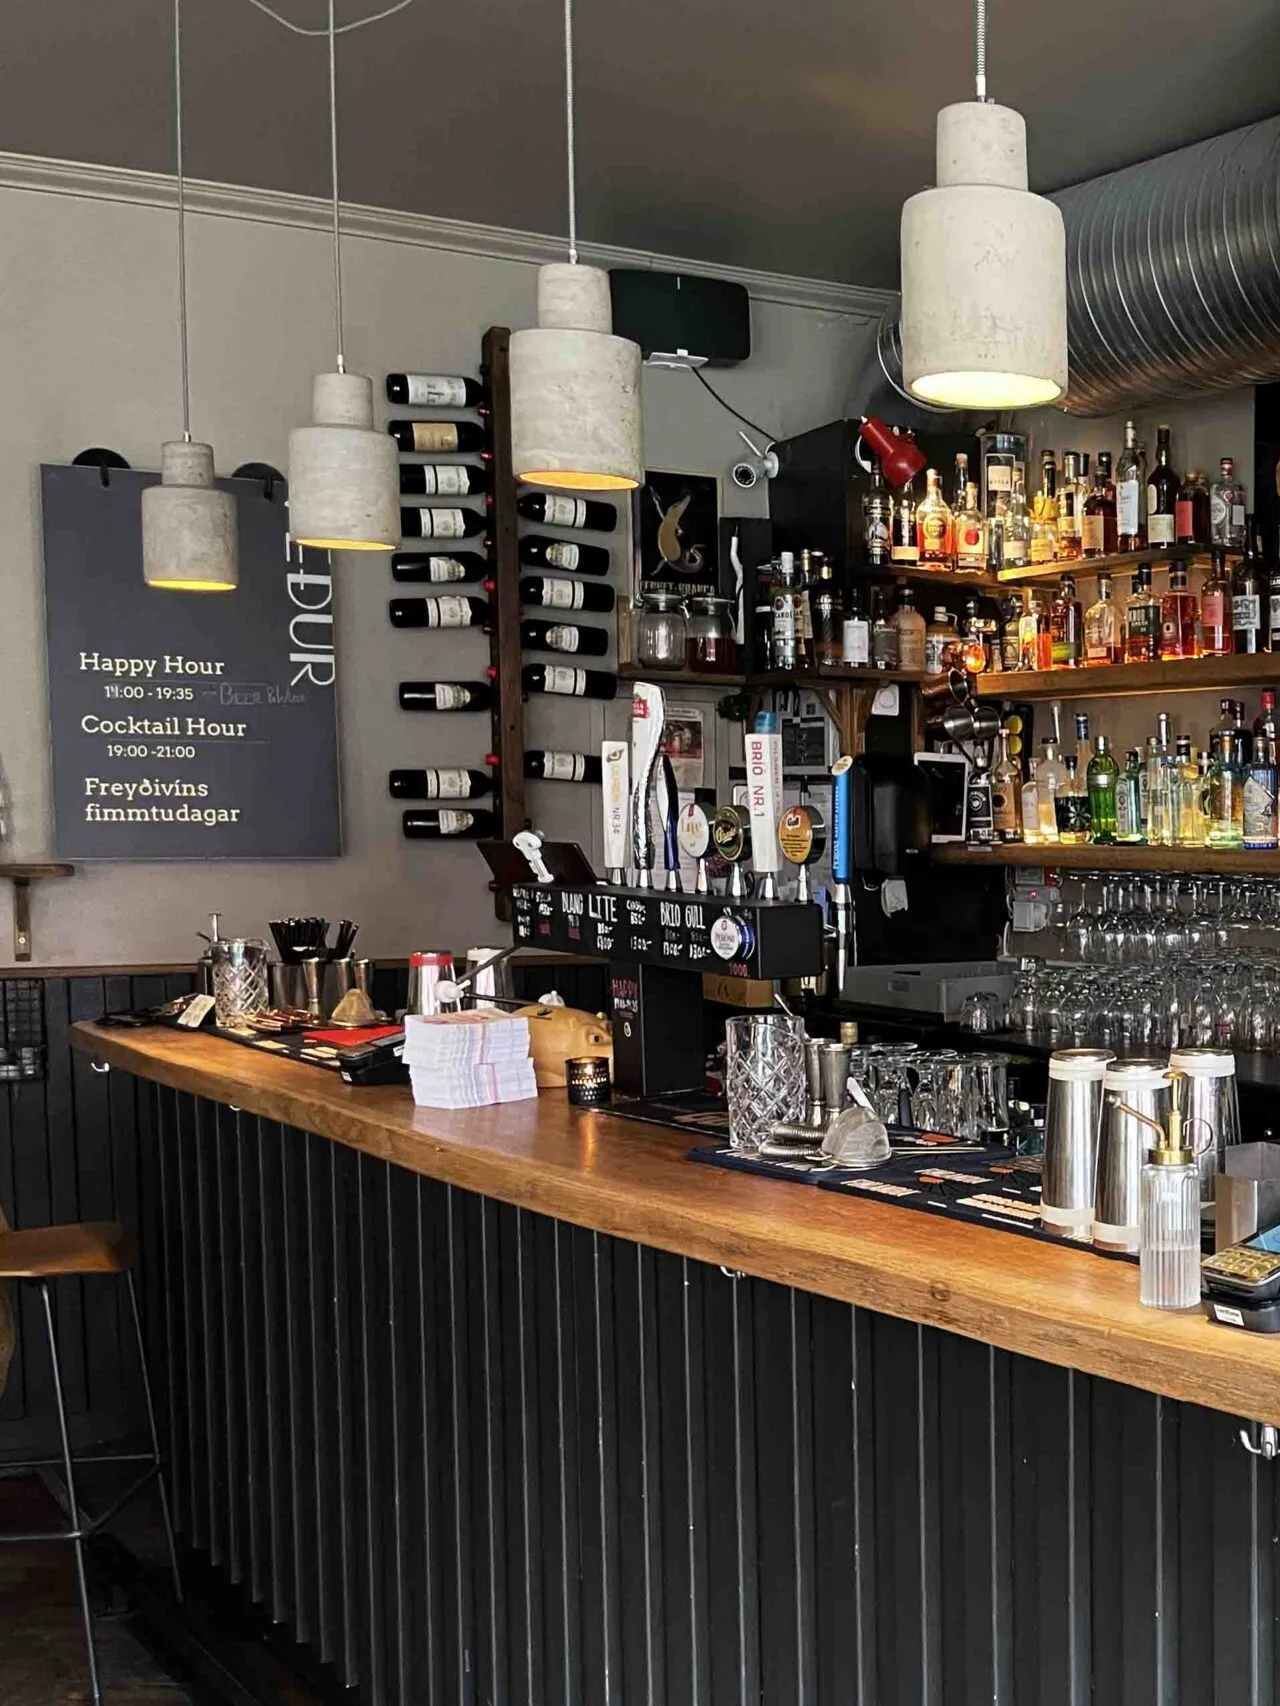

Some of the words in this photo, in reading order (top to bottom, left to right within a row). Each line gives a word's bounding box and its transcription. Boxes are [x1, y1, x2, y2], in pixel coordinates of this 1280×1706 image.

[284, 500, 336, 686] EÐUR
[79, 652, 156, 677] Happy
[163, 656, 225, 676] Hour
[156, 686, 194, 701] 19:35
[81, 714, 181, 737] Cocktail
[186, 718, 247, 737] Hour
[107, 744, 148, 758] 19:00
[85, 778, 208, 801] Freyðivíns
[85, 804, 240, 826] fimmtudagar
[588, 893, 618, 922] LITE
